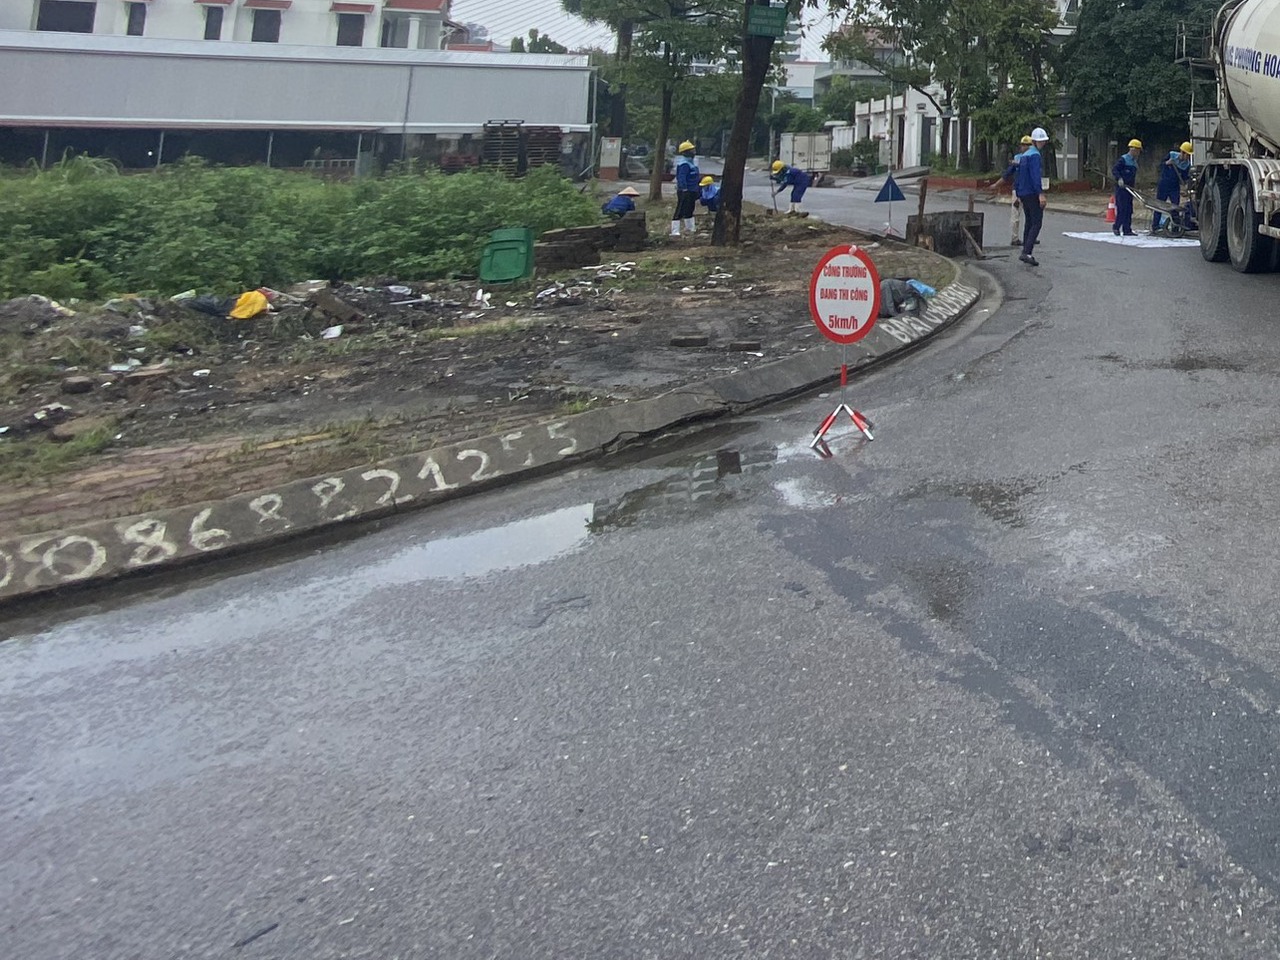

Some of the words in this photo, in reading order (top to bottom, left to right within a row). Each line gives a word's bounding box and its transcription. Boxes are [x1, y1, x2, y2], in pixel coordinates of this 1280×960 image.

[823, 264, 841, 277] CÔNG
[842, 264, 867, 278] TRƯỜNG
[820, 288, 837, 300] ĐANG
[839, 288, 849, 300] THI
[850, 287, 868, 301] CÔNG
[828, 314, 858, 330] 5km/h
